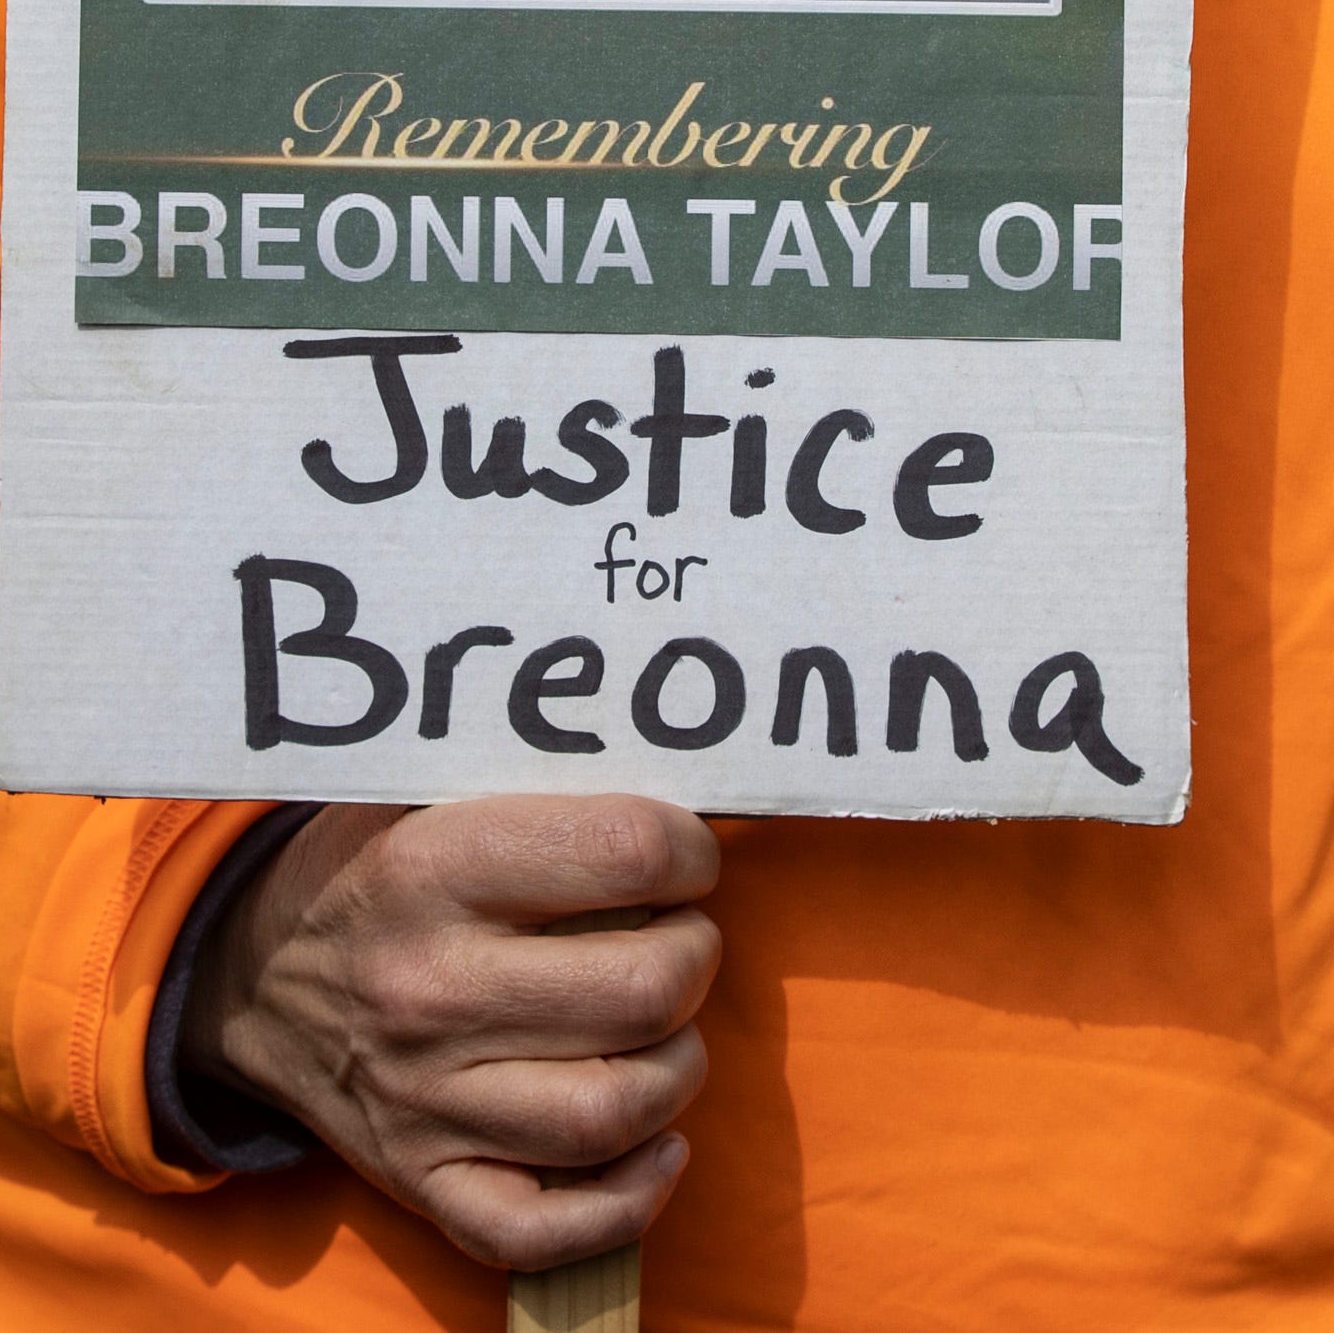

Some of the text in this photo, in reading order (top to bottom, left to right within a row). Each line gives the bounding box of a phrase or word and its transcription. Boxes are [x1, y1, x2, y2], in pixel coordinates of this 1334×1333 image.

[280, 71, 948, 206] Remembering
[76, 190, 1123, 292] BREONNA TAYLOR
[282, 333, 995, 541] Justice
[593, 522, 708, 603] for
[233, 553, 1146, 787] Breonna
